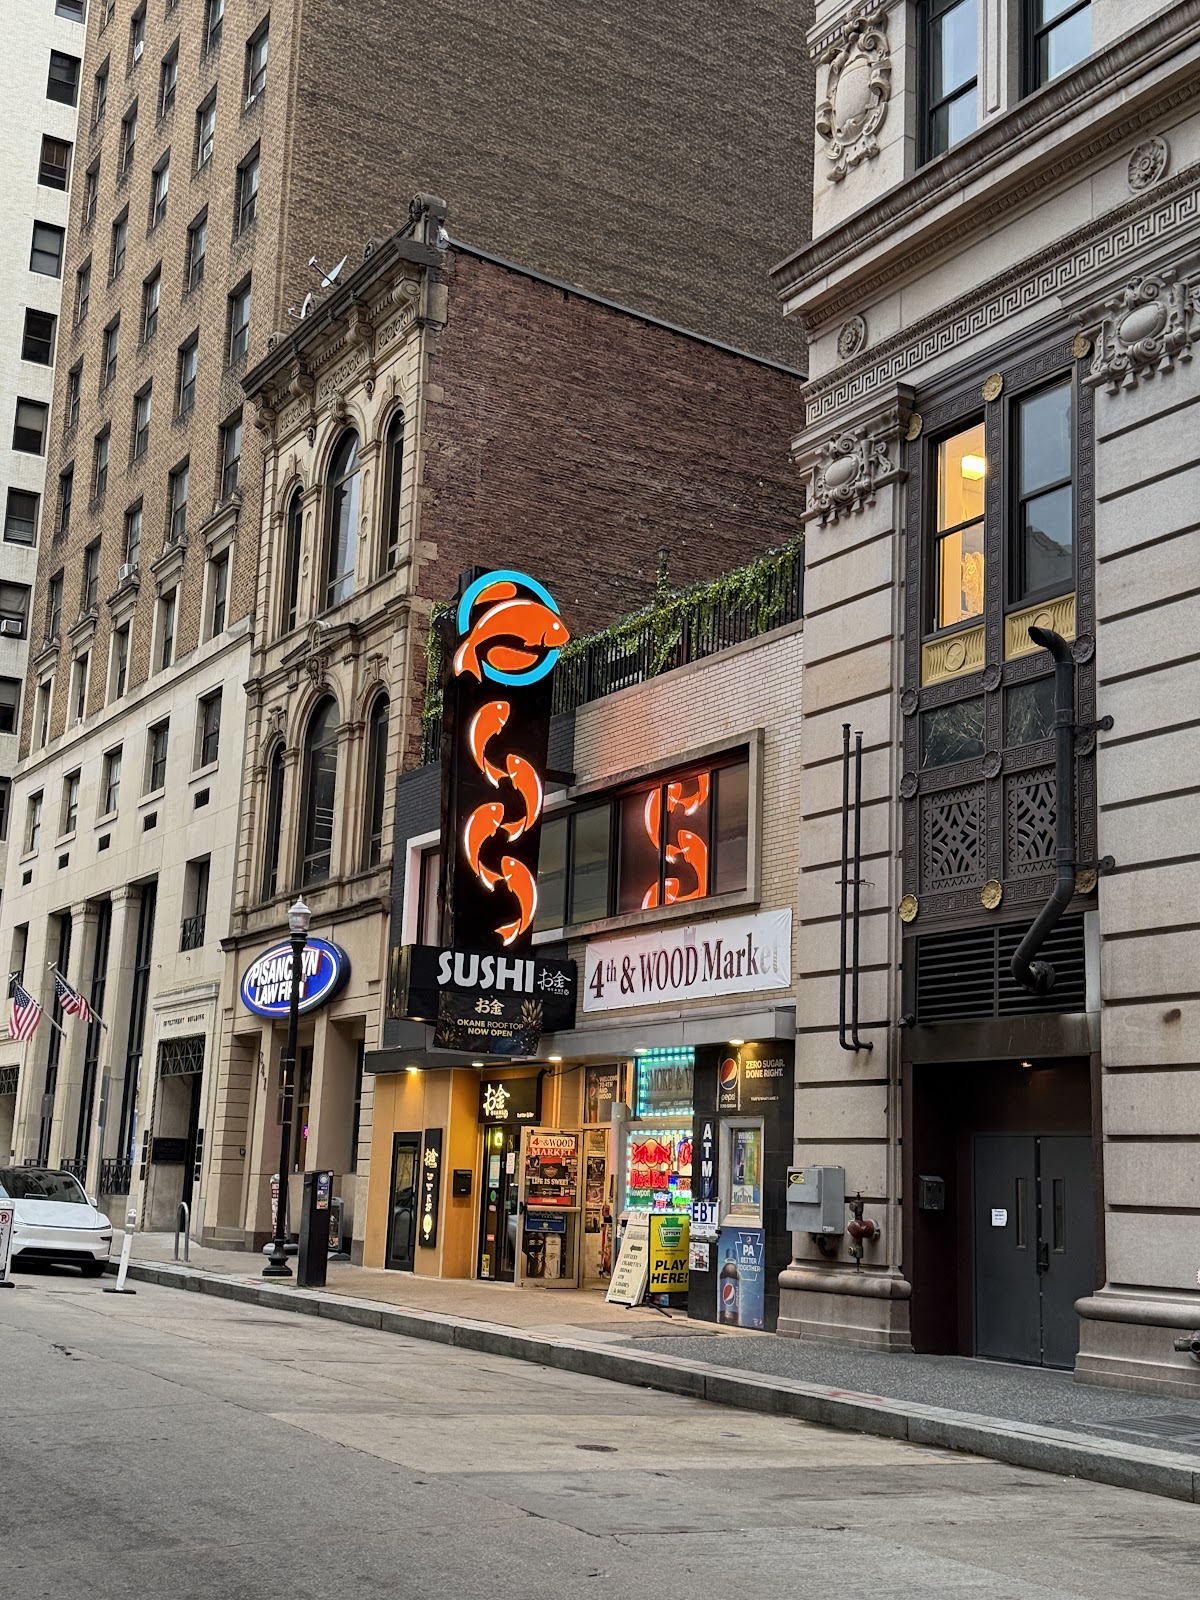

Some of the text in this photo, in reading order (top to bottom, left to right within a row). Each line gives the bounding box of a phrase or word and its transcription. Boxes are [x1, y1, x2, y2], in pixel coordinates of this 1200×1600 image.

[250, 948, 320, 988] PISANCYN
[589, 932, 781, 999] 4th & WOOD Market
[437, 951, 535, 993] SUSHI
[254, 983, 279, 1006] LAW
[474, 997, 506, 1016] お金
[457, 1018, 524, 1031] OKANE ROOFTOP
[467, 1027, 513, 1038] NOW OPEN
[745, 1058, 786, 1070] ZERO SUGAR.
[745, 1068, 784, 1079] DONE RIGHT.
[720, 1093, 736, 1102] pepsi
[549, 1138, 574, 1147] WOOD
[531, 1147, 573, 1157] MARKET
[701, 1122, 713, 1178] ATM
[531, 1177, 544, 1185] LIFE
[551, 1178, 569, 1186] SWEET
[630, 1168, 652, 1188] Red
[692, 1202, 717, 1222] EBT
[742, 1244, 755, 1256] PA
[654, 1259, 687, 1271] PLAY
[740, 1256, 757, 1264] BETTER
[651, 1272, 688, 1284] HERE!
